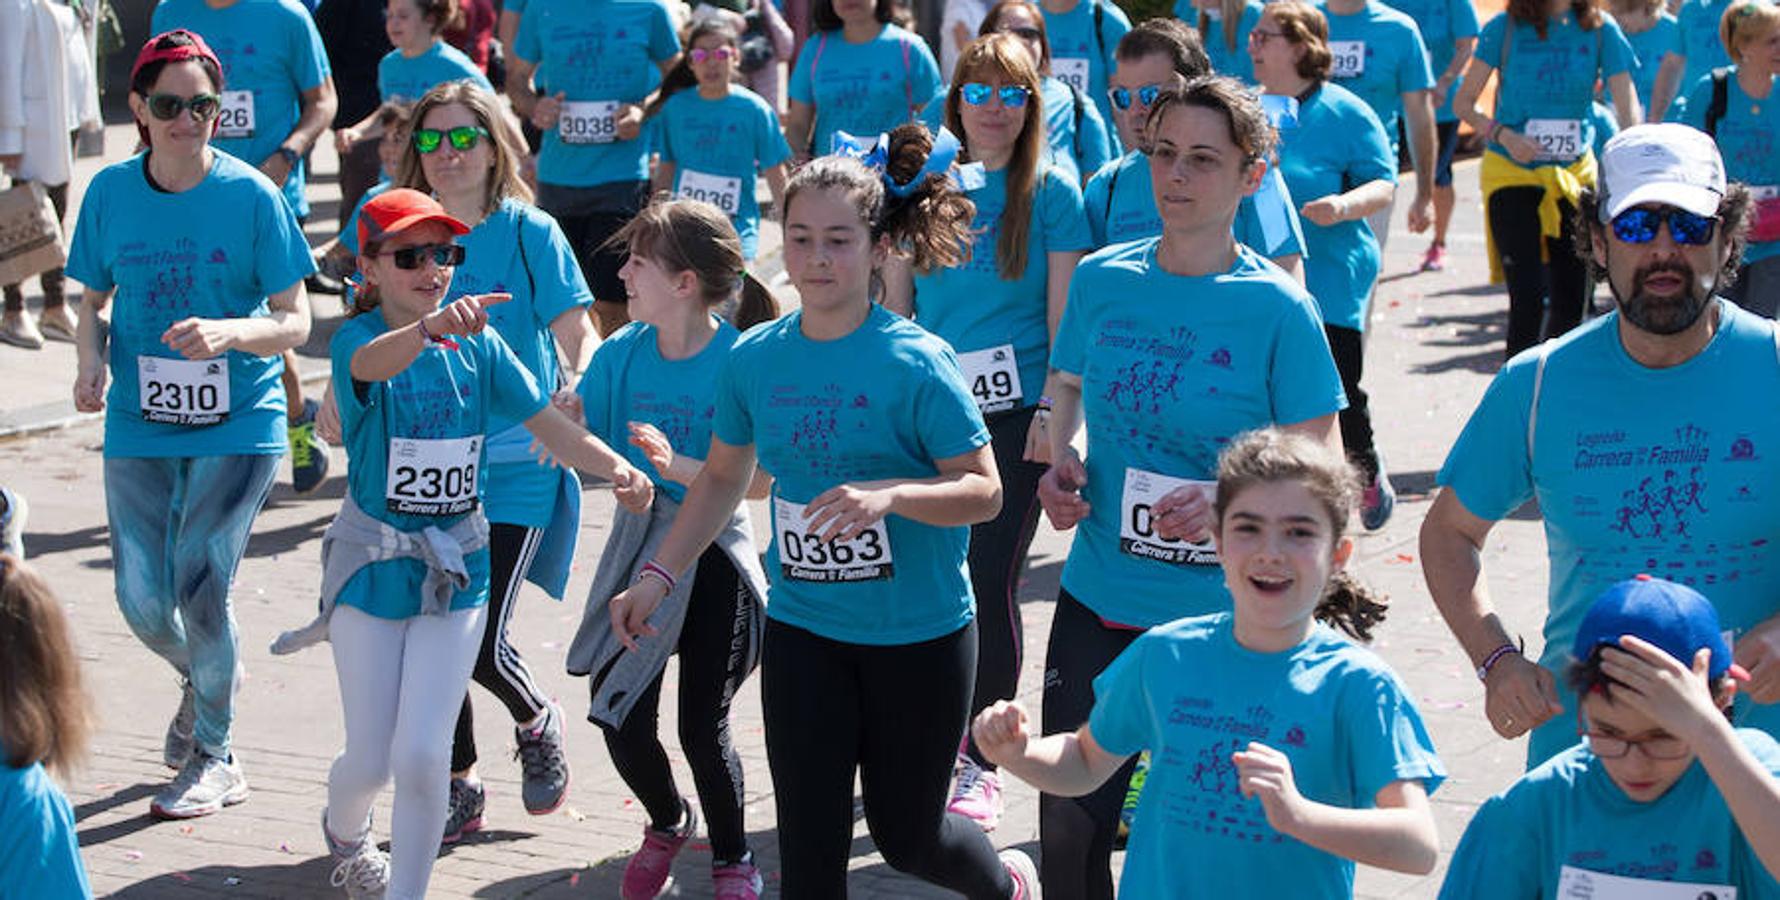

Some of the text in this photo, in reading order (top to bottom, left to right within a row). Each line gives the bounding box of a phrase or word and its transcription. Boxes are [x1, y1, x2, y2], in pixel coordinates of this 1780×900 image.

[221, 108, 248, 128] 26
[562, 116, 615, 135] 3038
[147, 381, 218, 411] 2310
[972, 370, 1013, 400] 49
[1575, 449, 1634, 469] Carrera
[1649, 445, 1710, 465] Familia
[394, 464, 475, 499] 2309
[784, 528, 883, 564] 0363
[1131, 541, 1175, 561] Carrera
